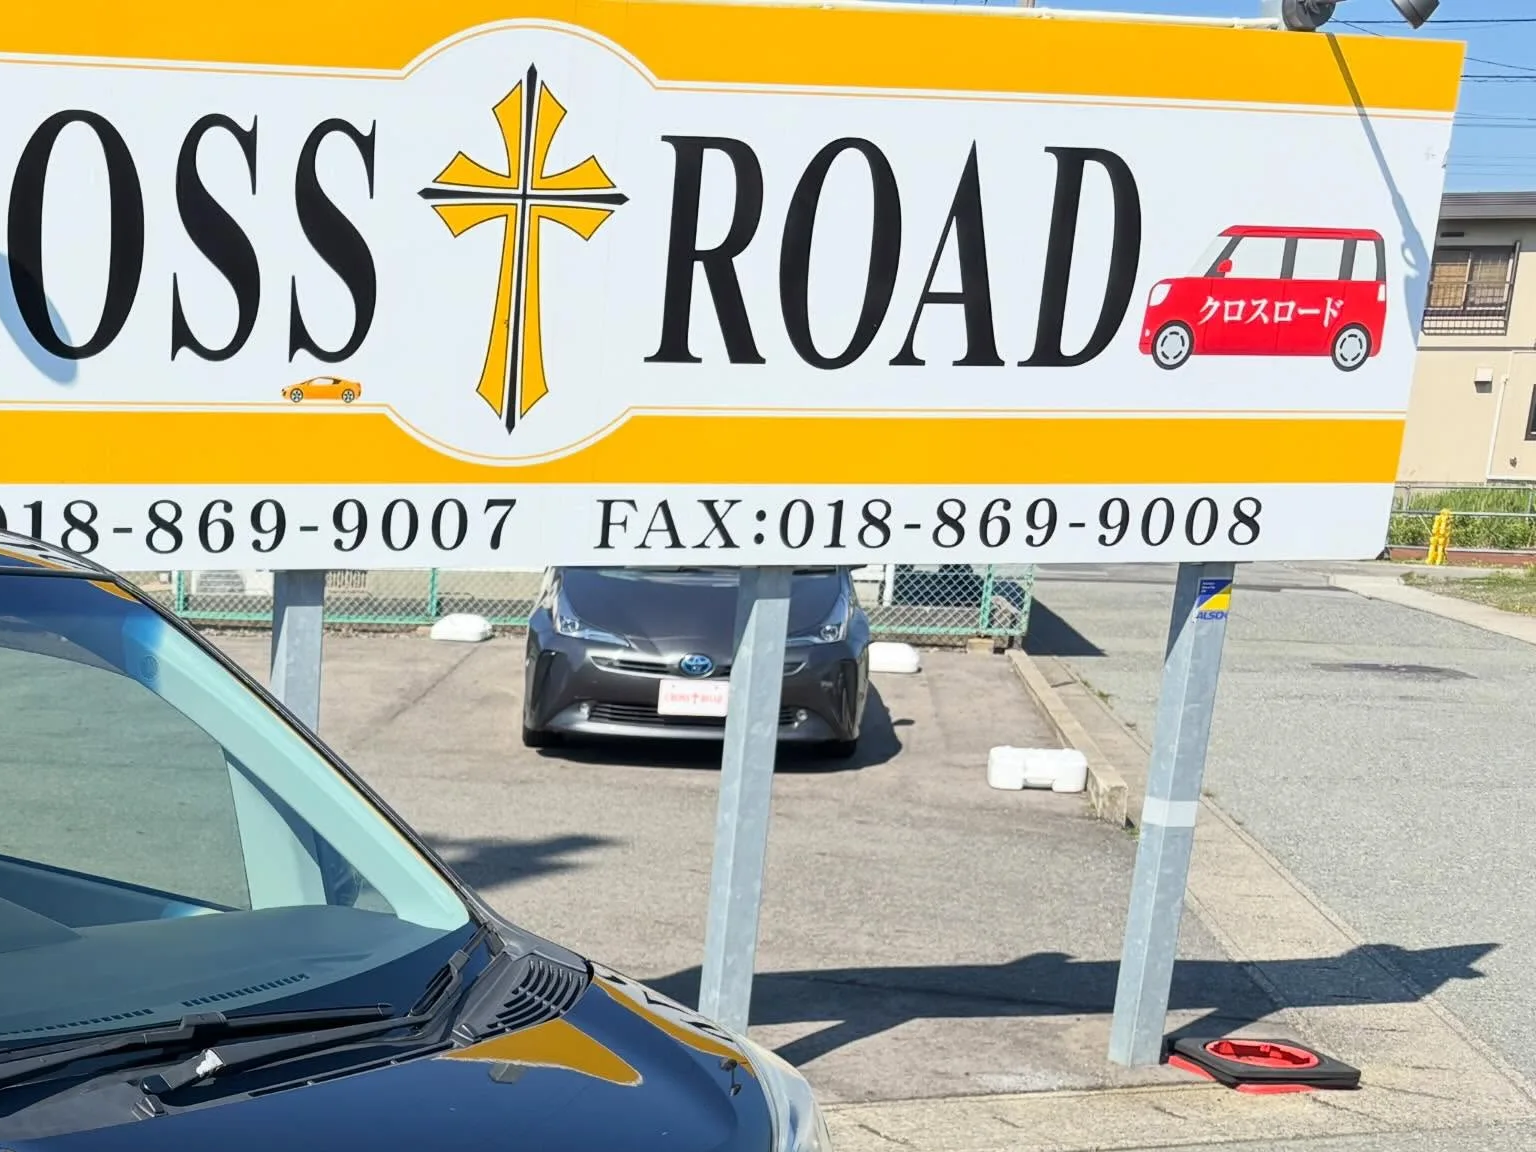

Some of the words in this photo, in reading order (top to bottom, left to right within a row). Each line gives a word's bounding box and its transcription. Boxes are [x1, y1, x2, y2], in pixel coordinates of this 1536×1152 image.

[643, 135, 1142, 370] ROAD
[1198, 296, 1345, 328] クロスロード
[594, 496, 1263, 550] FAX:018-869-9008
